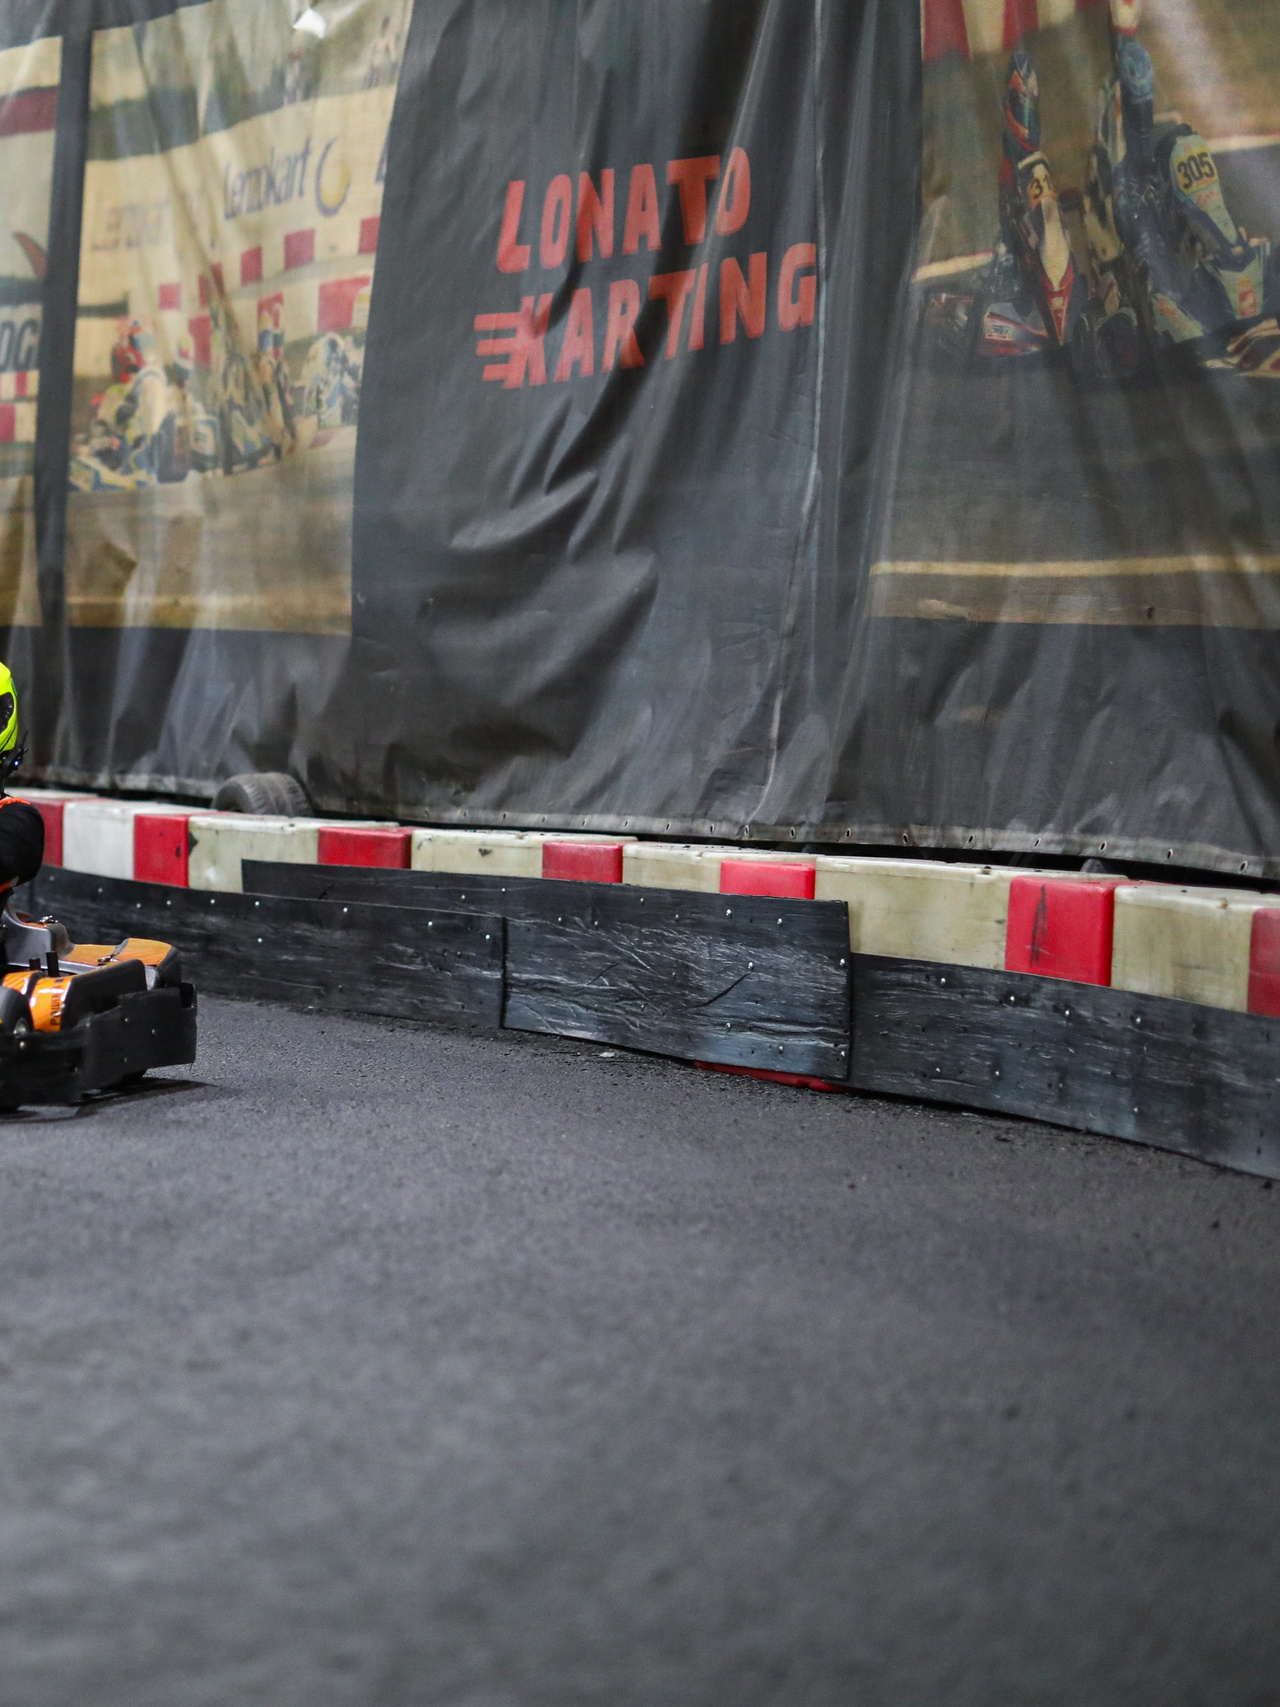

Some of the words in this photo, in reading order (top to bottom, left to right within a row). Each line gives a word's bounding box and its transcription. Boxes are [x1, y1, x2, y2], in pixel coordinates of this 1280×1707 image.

[497, 147, 751, 273] LONATO
[1176, 152, 1215, 190] 305
[474, 242, 817, 389] KARTING
